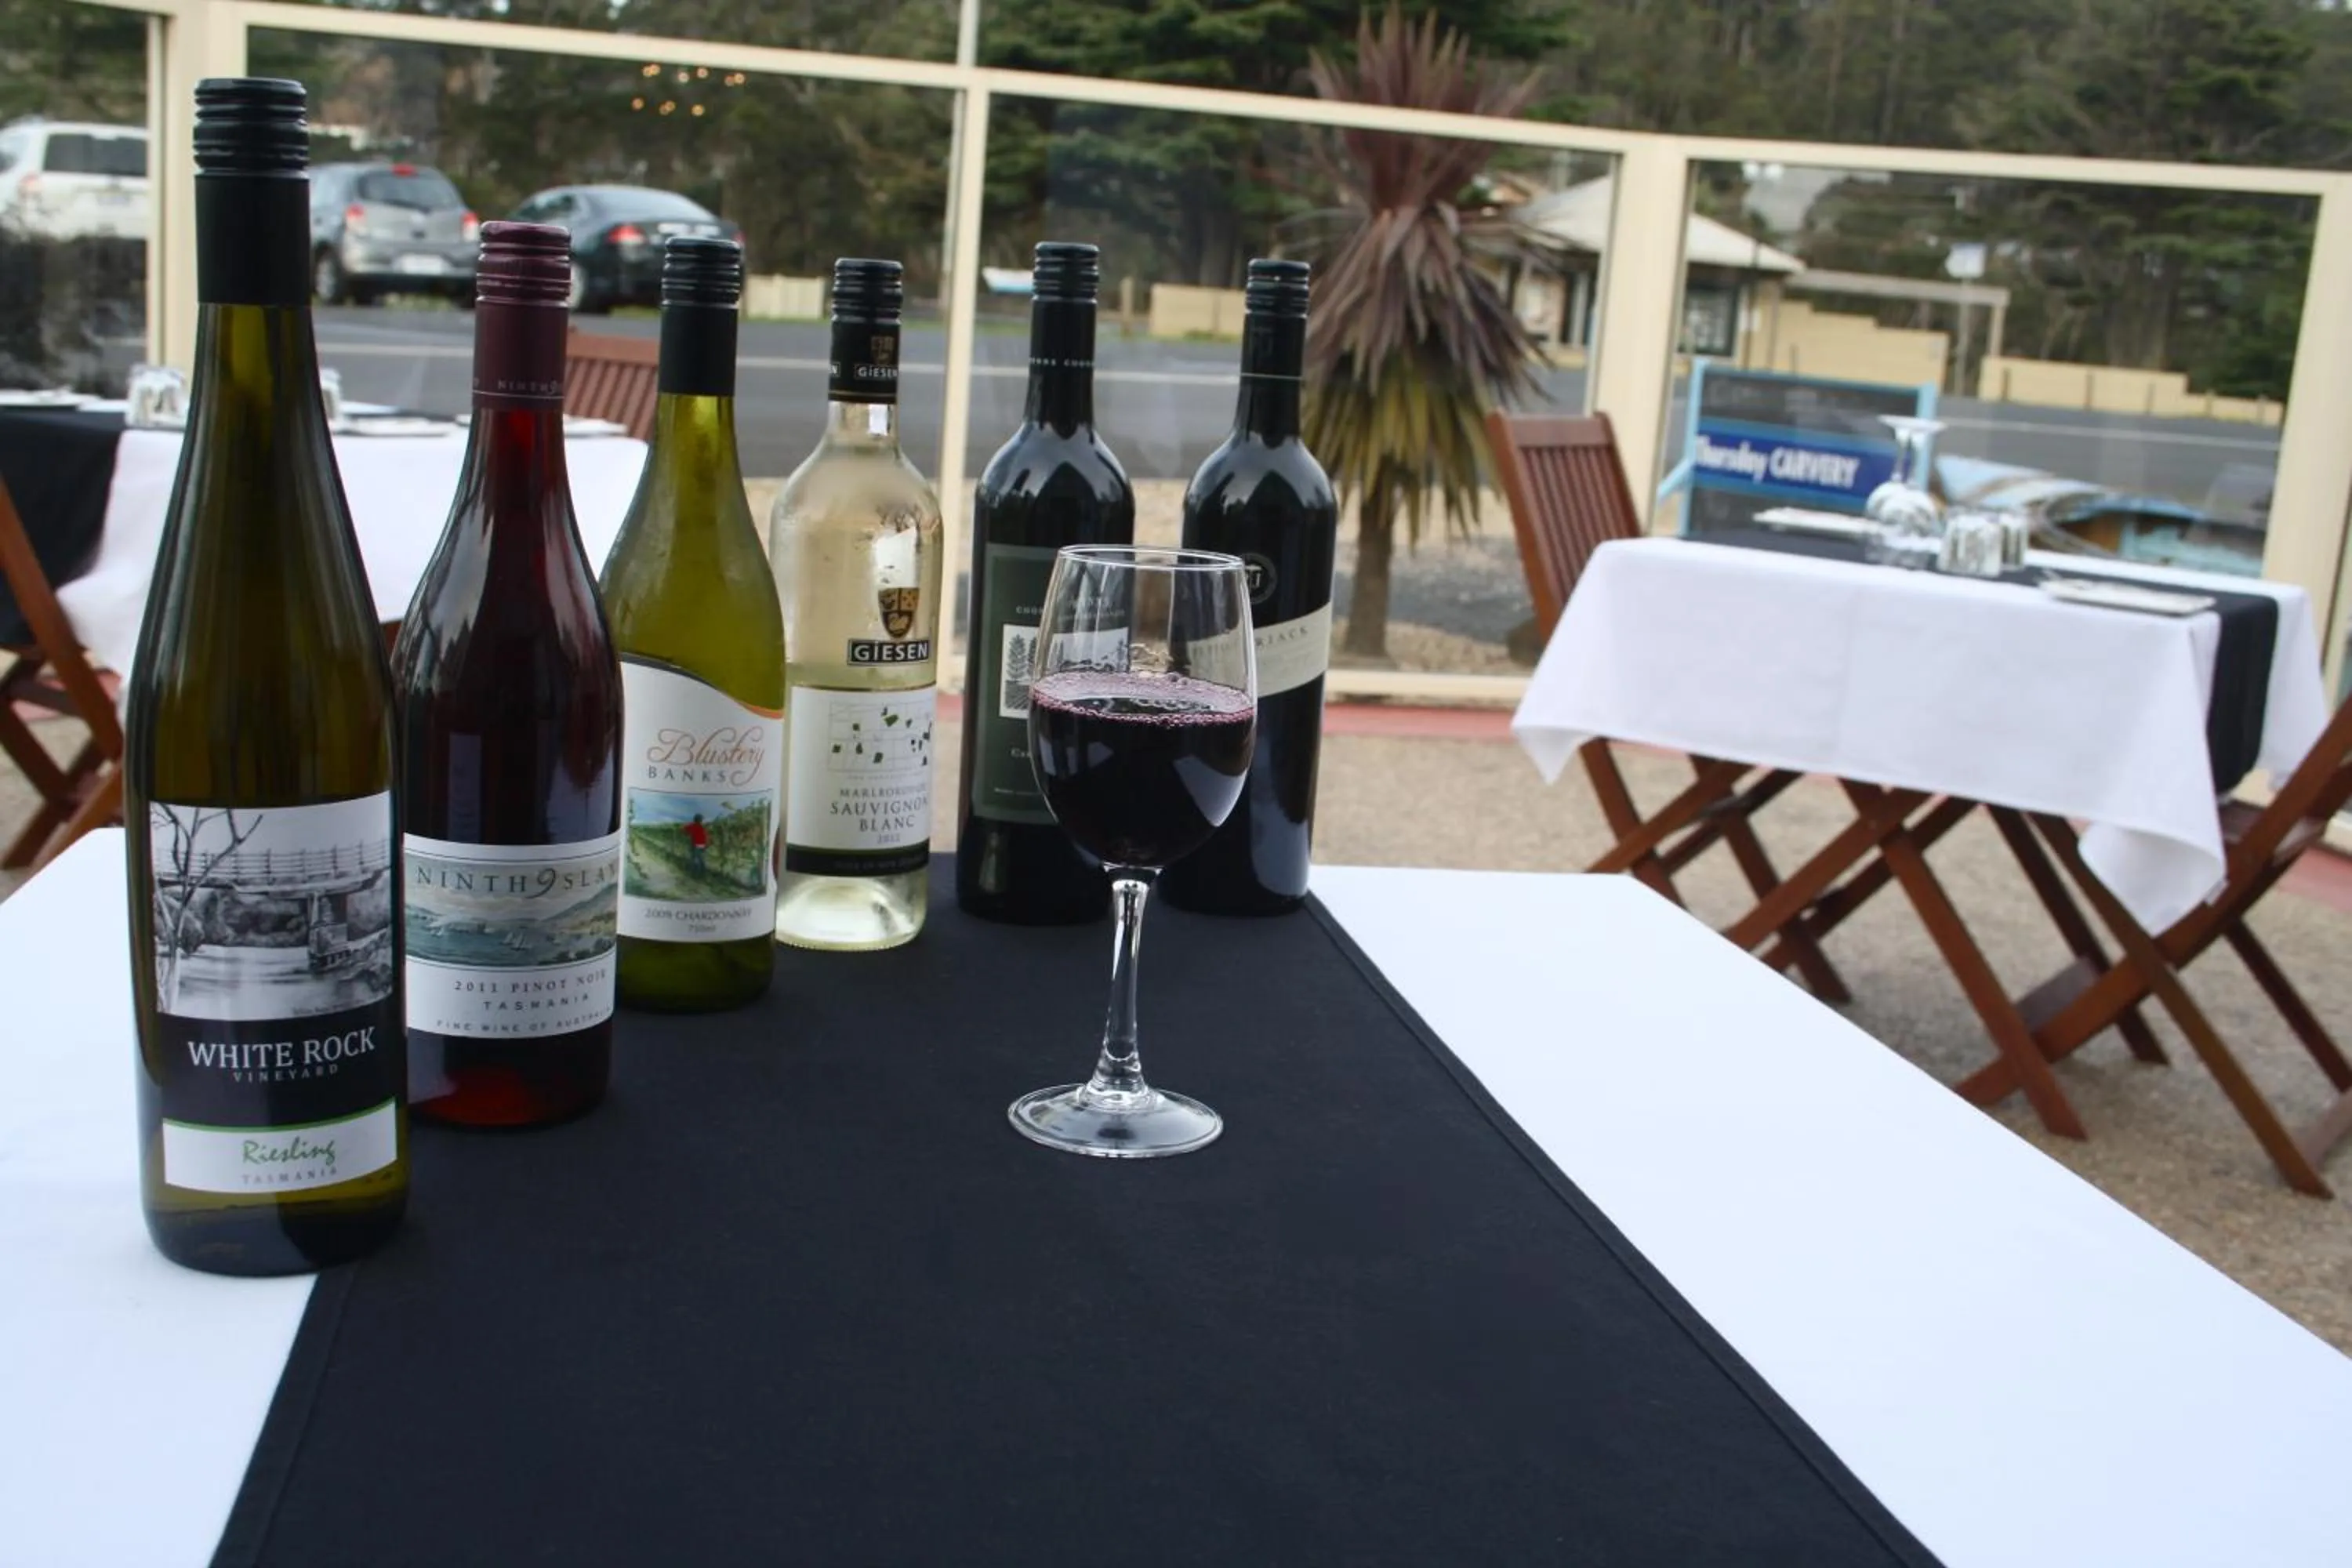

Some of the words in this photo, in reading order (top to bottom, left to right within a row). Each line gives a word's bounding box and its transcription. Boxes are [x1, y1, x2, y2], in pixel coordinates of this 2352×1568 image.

[1769, 446, 1860, 488] CARVERY
[853, 641, 928, 661] GIESEN
[647, 726, 766, 786] Blustery
[648, 764, 726, 782] BANKS
[859, 815, 916, 832] BLANC
[454, 981, 498, 993] 2011
[511, 978, 566, 993] PINOT
[575, 969, 606, 987] NOIR
[483, 993, 589, 1011] TASMANIA
[187, 1040, 293, 1069] WHITE
[303, 1025, 376, 1065] ROCK
[234, 1063, 339, 1083] VINEYARD
[242, 1136, 336, 1167] Riesling
[242, 1166, 337, 1185] TASMANIA
